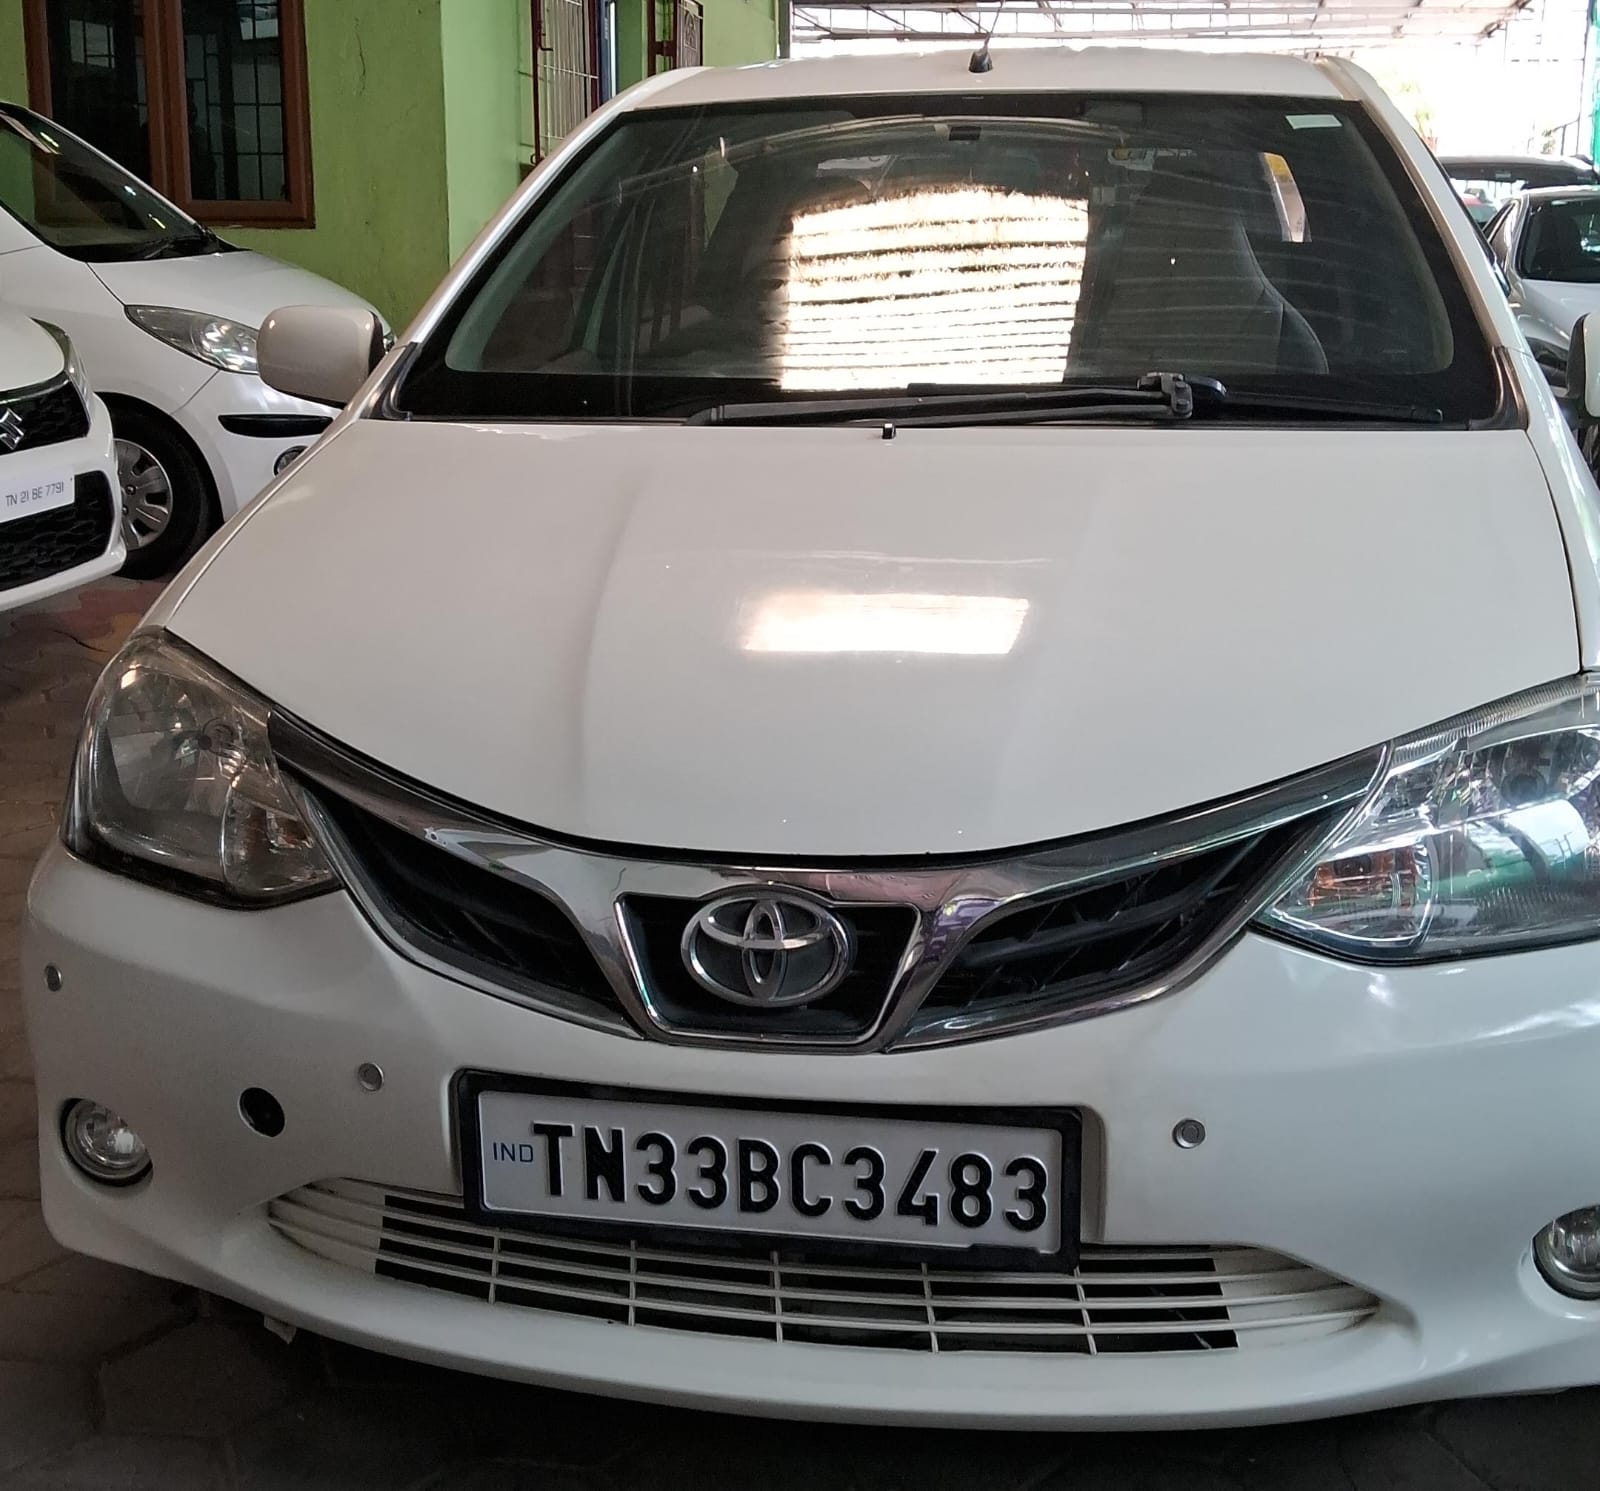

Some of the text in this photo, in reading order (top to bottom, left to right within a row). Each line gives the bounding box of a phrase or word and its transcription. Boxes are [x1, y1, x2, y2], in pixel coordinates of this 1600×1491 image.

[5, 494, 18, 506] TN
[20, 490, 29, 503] 21
[32, 486, 43, 500] BE
[493, 1121, 1048, 1232] IND TN33BC3483
